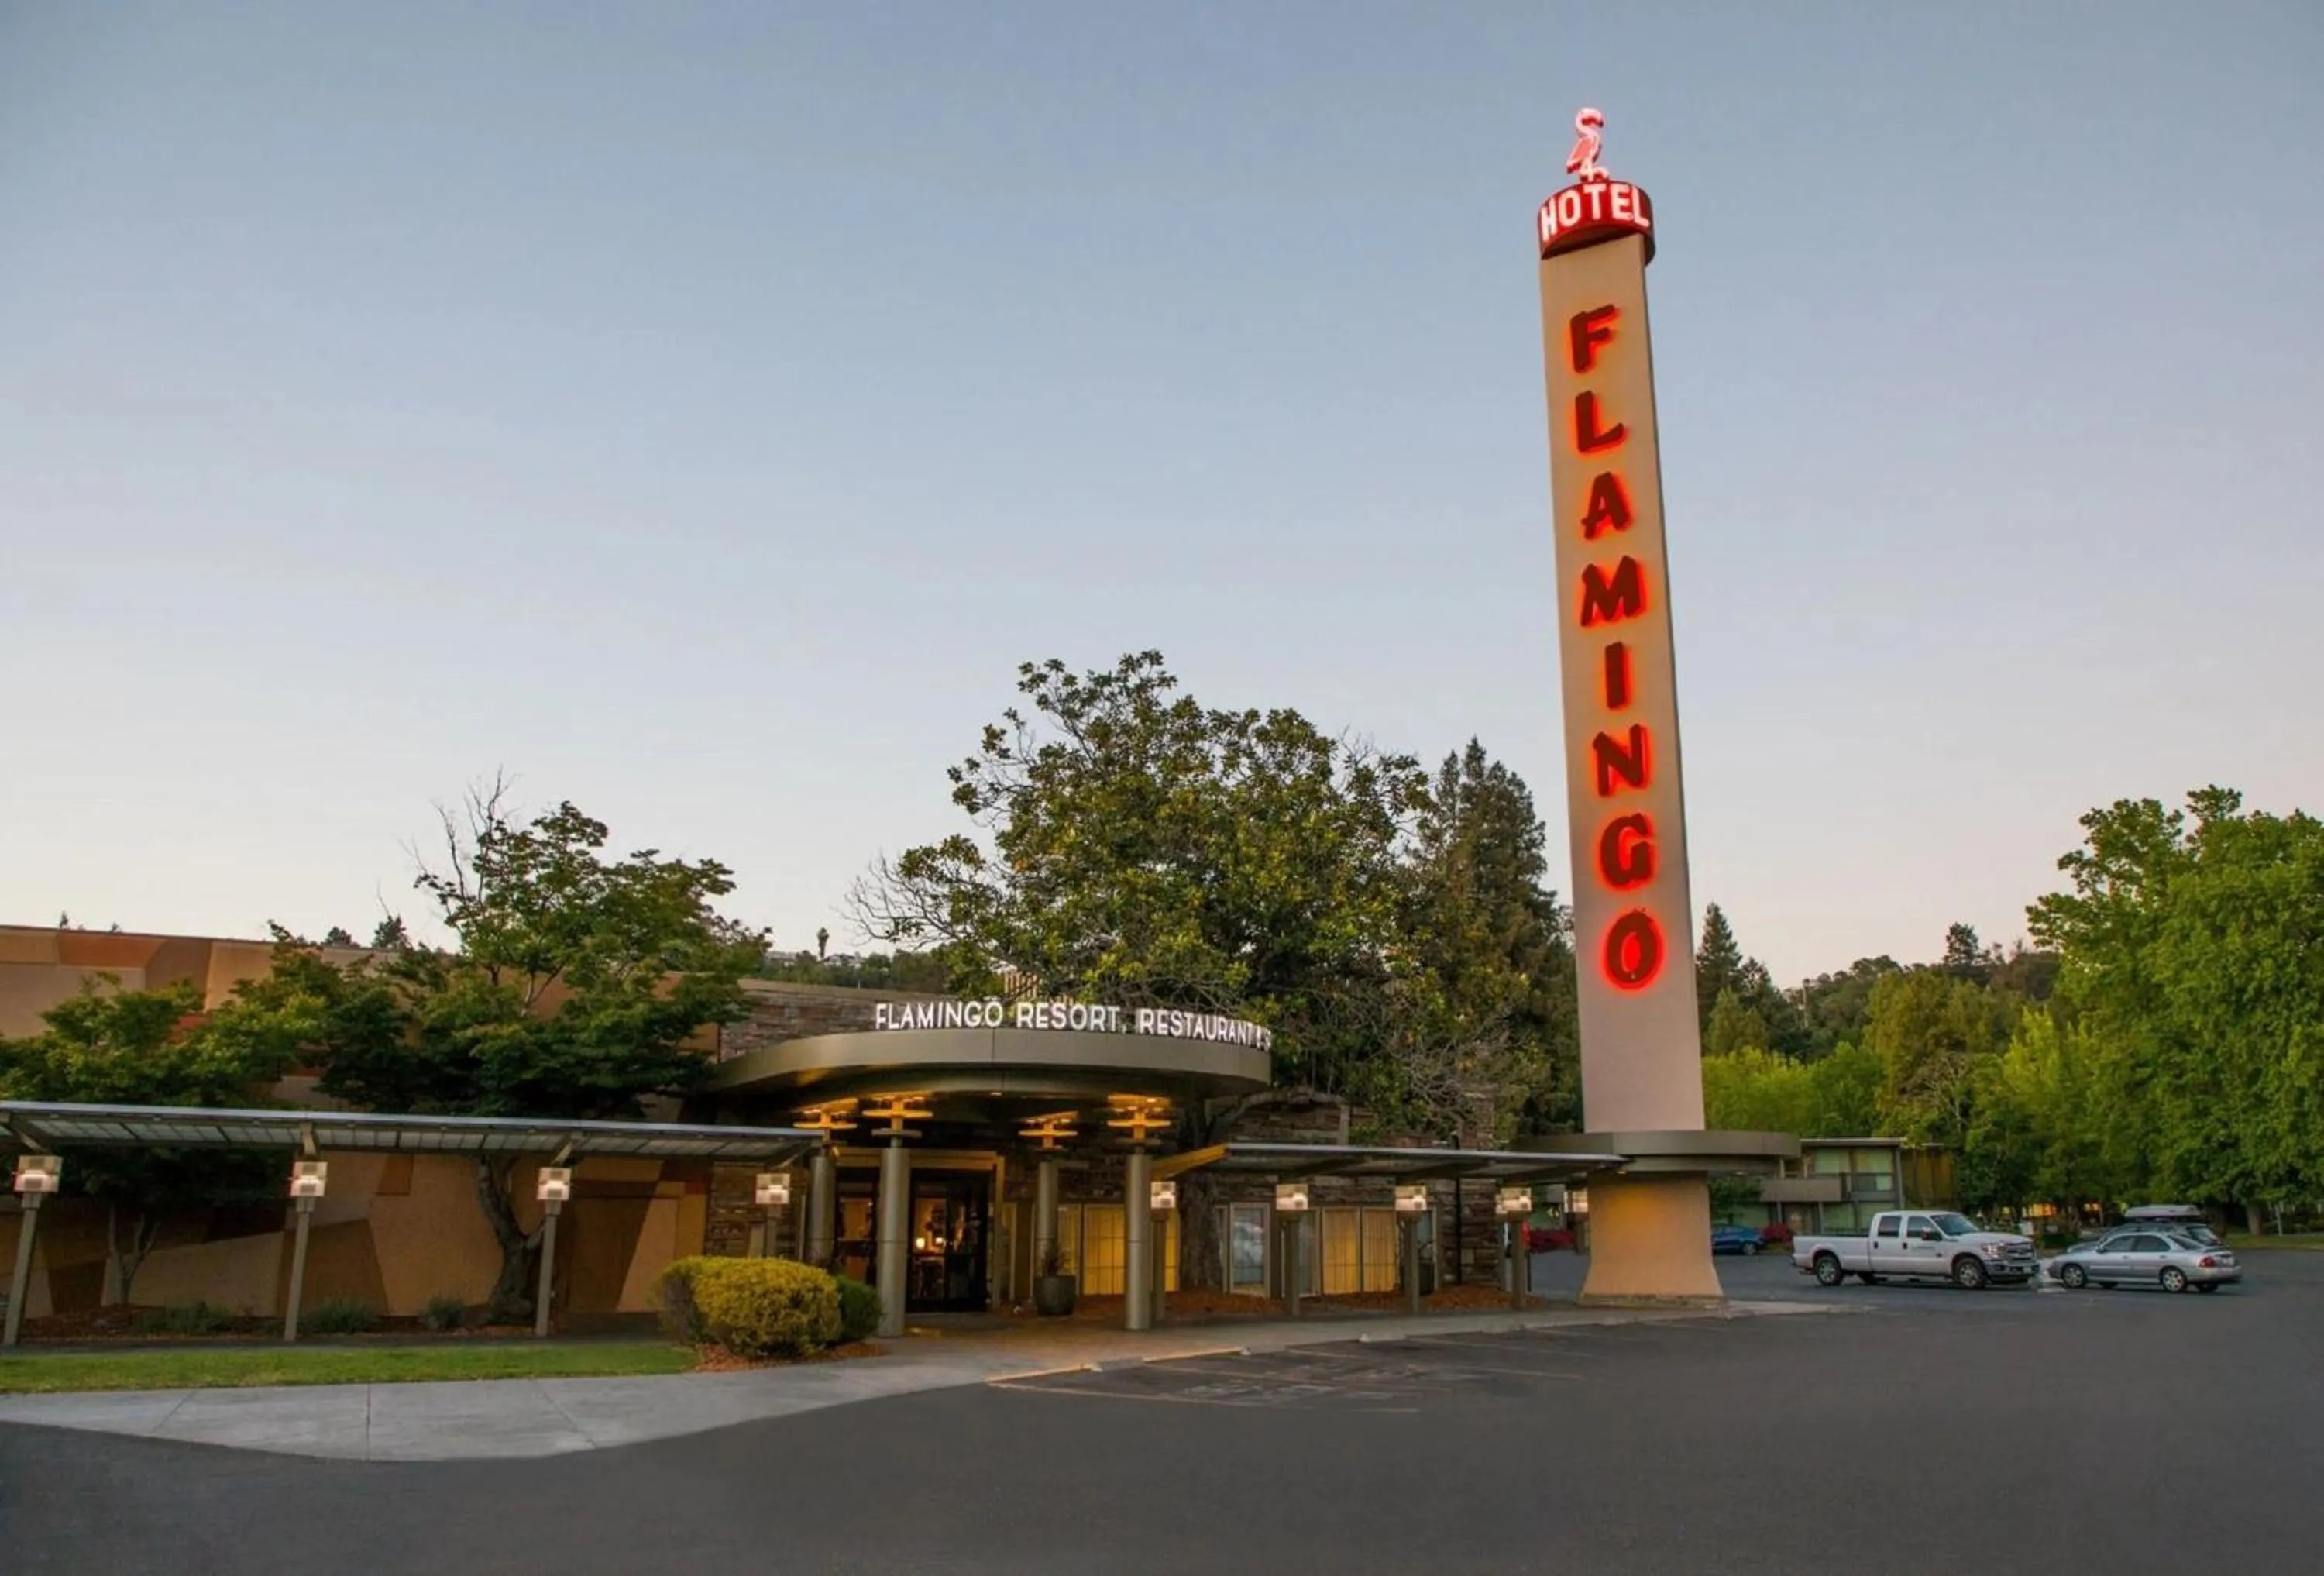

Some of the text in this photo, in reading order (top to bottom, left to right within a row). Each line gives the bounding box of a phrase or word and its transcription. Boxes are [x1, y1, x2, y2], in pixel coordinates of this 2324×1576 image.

[1540, 183, 1650, 242] HOTEL
[1569, 303, 1660, 986] FLAMINGO
[875, 1000, 1004, 1030] FLAMINGO
